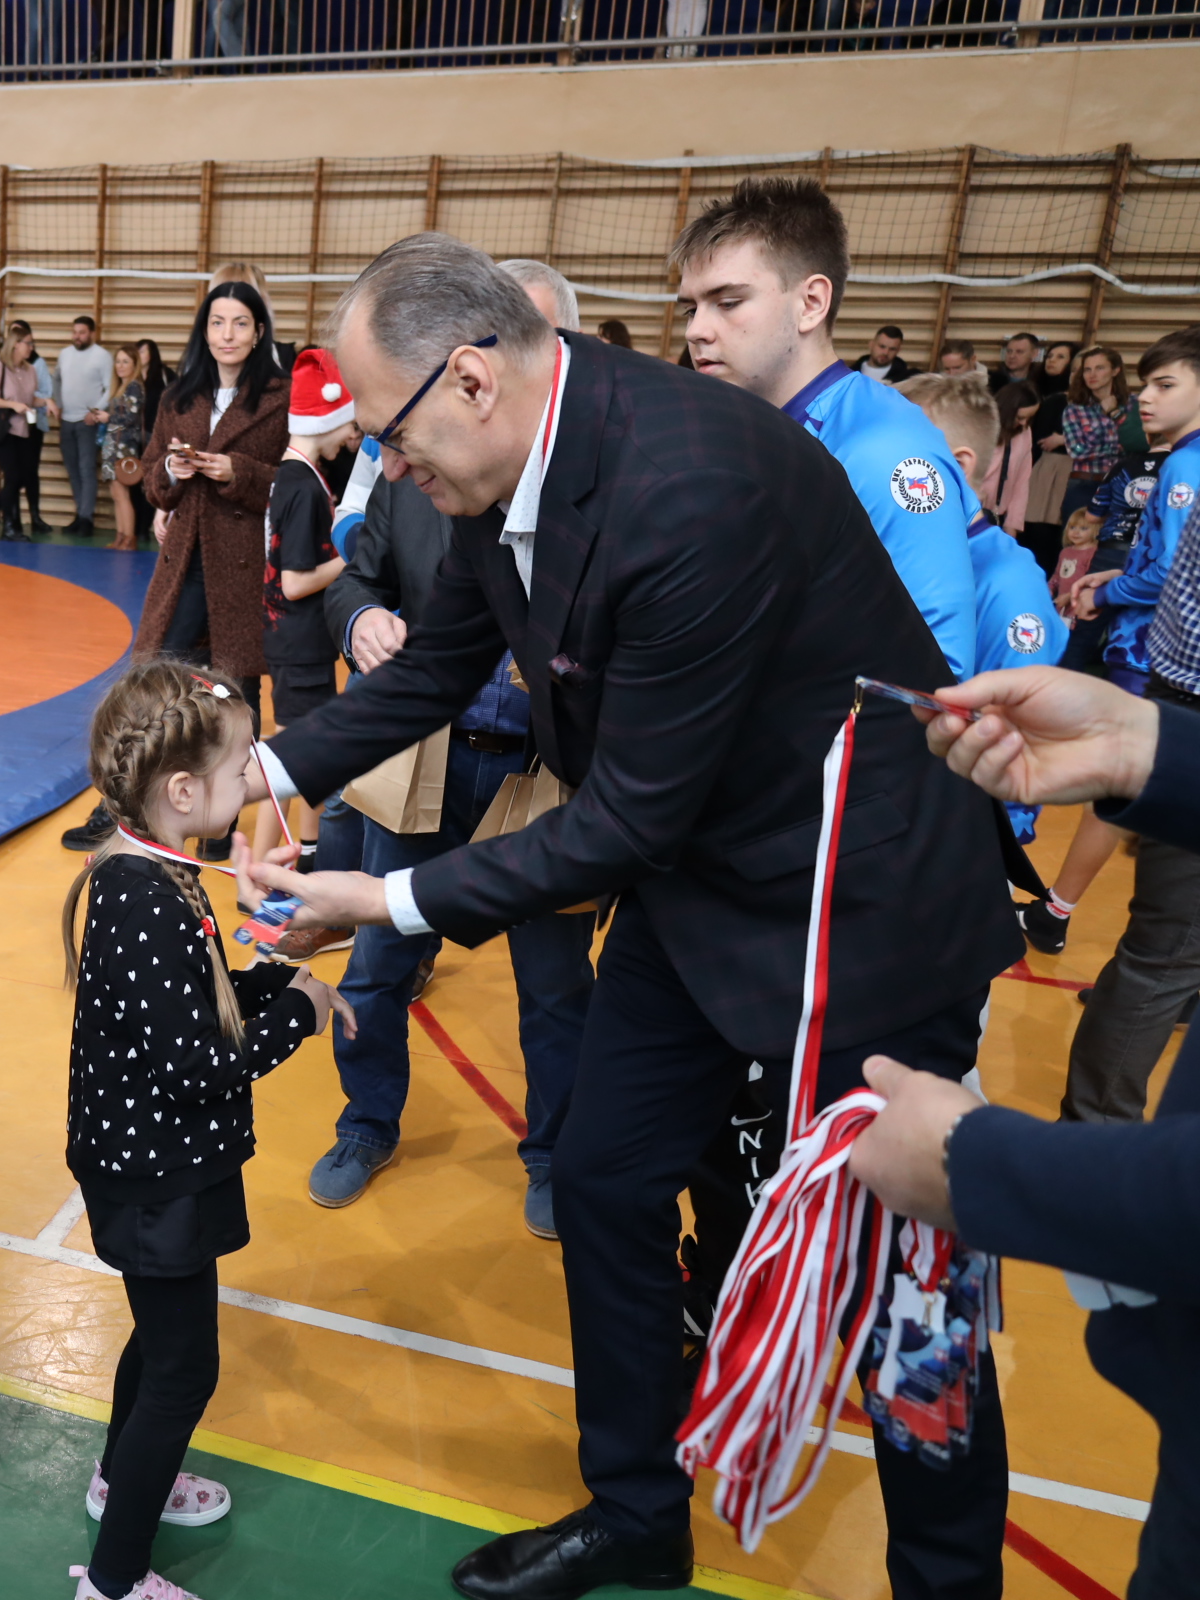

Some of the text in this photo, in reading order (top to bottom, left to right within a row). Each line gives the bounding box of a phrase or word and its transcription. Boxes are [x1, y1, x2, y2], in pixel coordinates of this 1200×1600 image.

[892, 468, 902, 483] UKS
[905, 495, 943, 514] RADOMSKO
[738, 1128, 770, 1208] NIK
